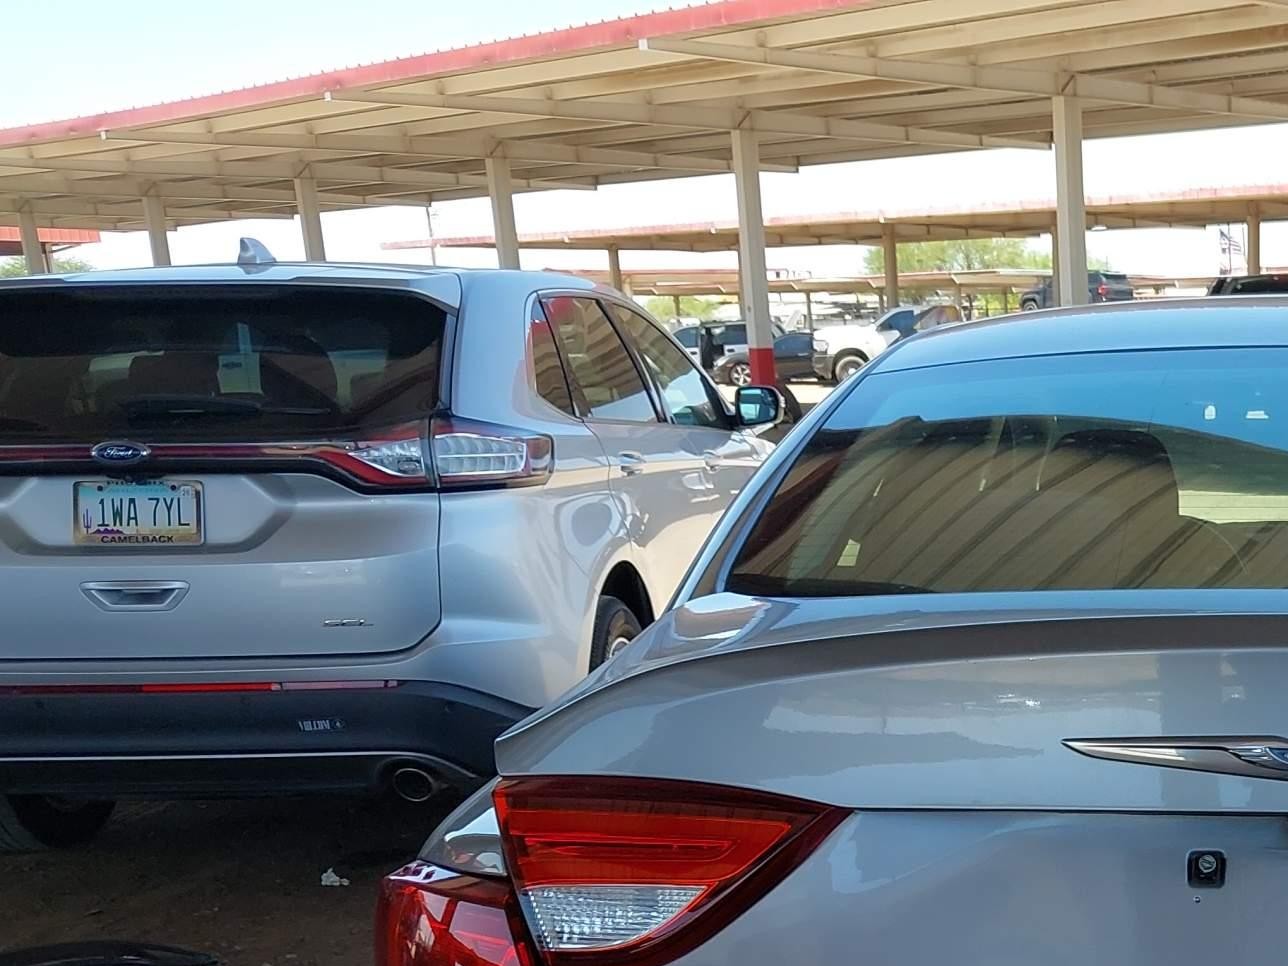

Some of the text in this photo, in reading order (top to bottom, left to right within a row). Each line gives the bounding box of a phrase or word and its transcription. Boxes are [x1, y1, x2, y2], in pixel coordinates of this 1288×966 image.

[103, 446, 133, 458] Ford
[97, 497, 190, 527] 1WA 7YL
[100, 535, 175, 544] CAMELBACK
